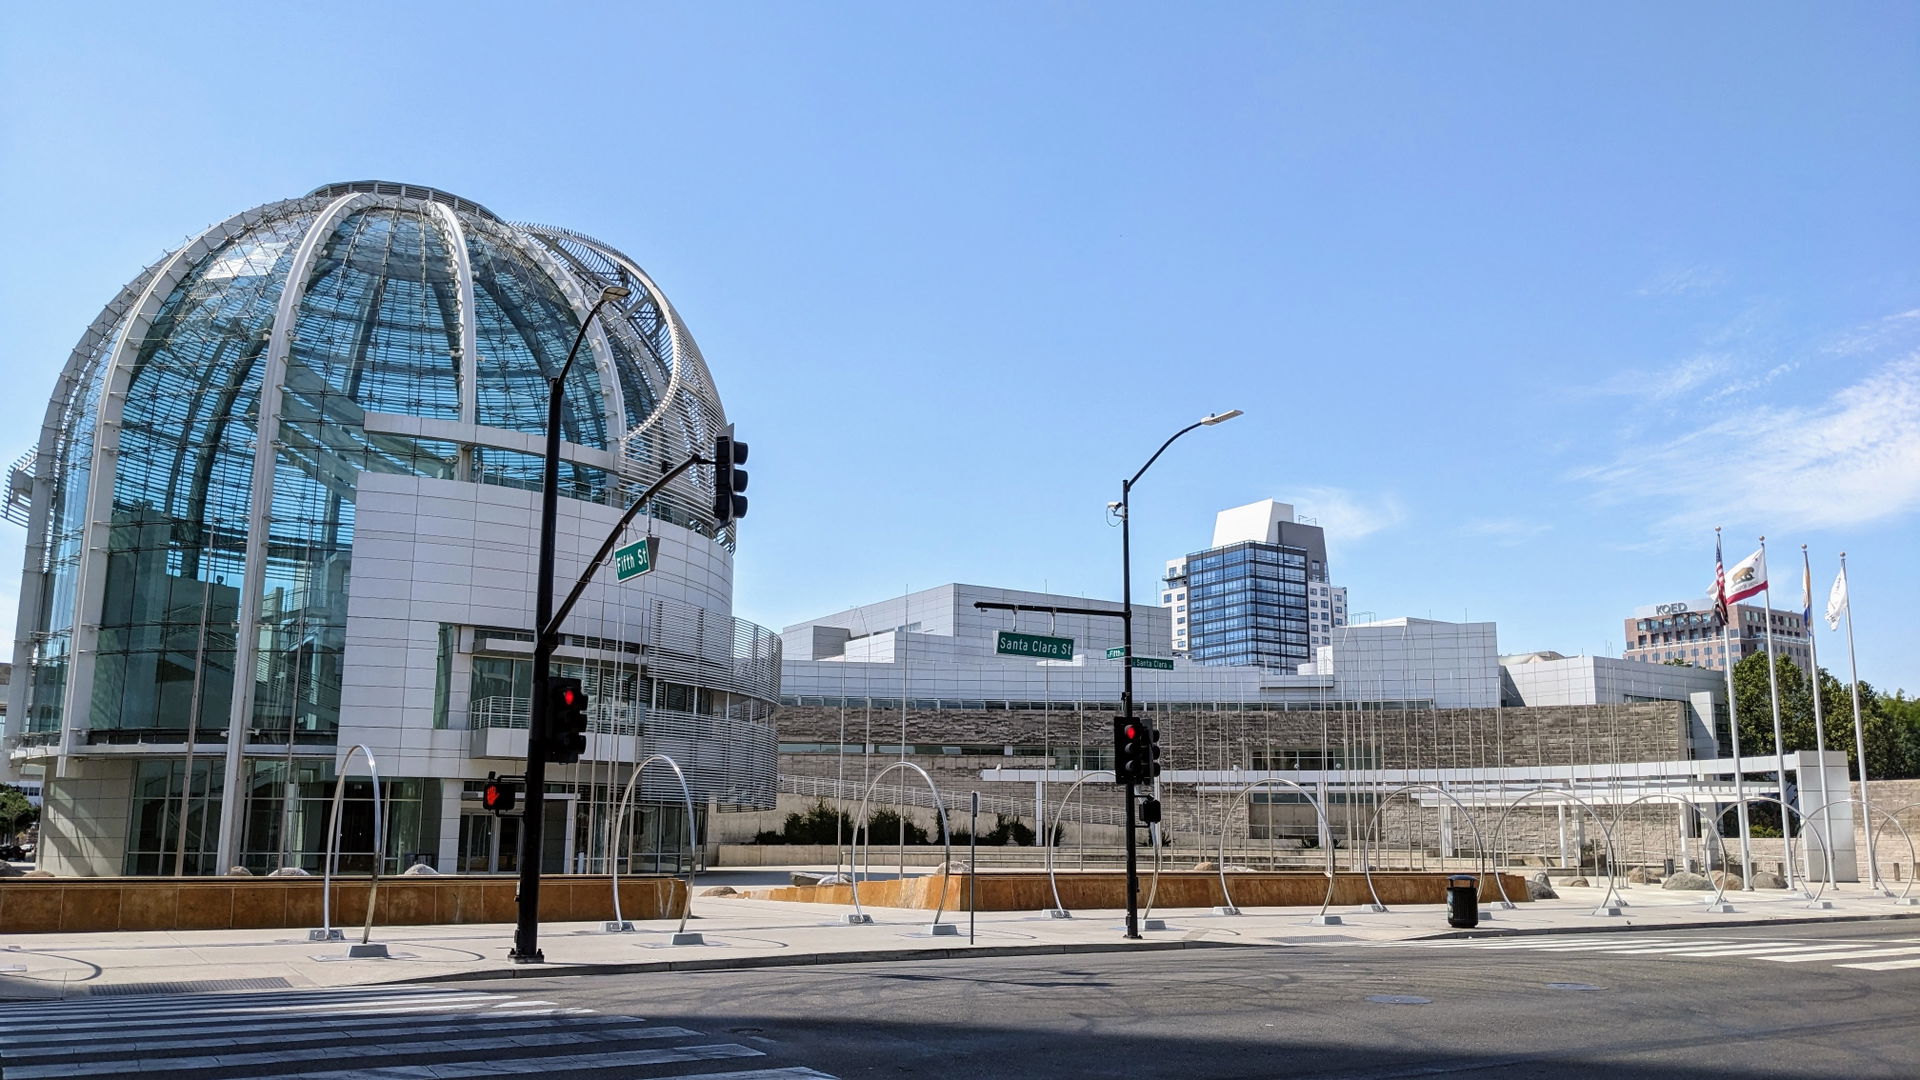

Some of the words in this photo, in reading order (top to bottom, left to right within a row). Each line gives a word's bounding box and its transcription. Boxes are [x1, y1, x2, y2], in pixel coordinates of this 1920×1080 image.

[616, 553, 635, 573] Fifth
[637, 548, 648, 565] St
[1000, 637, 1028, 651] Santa
[1032, 640, 1057, 654] Clara
[1061, 643, 1072, 655] St
[1136, 658, 1152, 668] Santa
[1153, 660, 1168, 669] Clara
